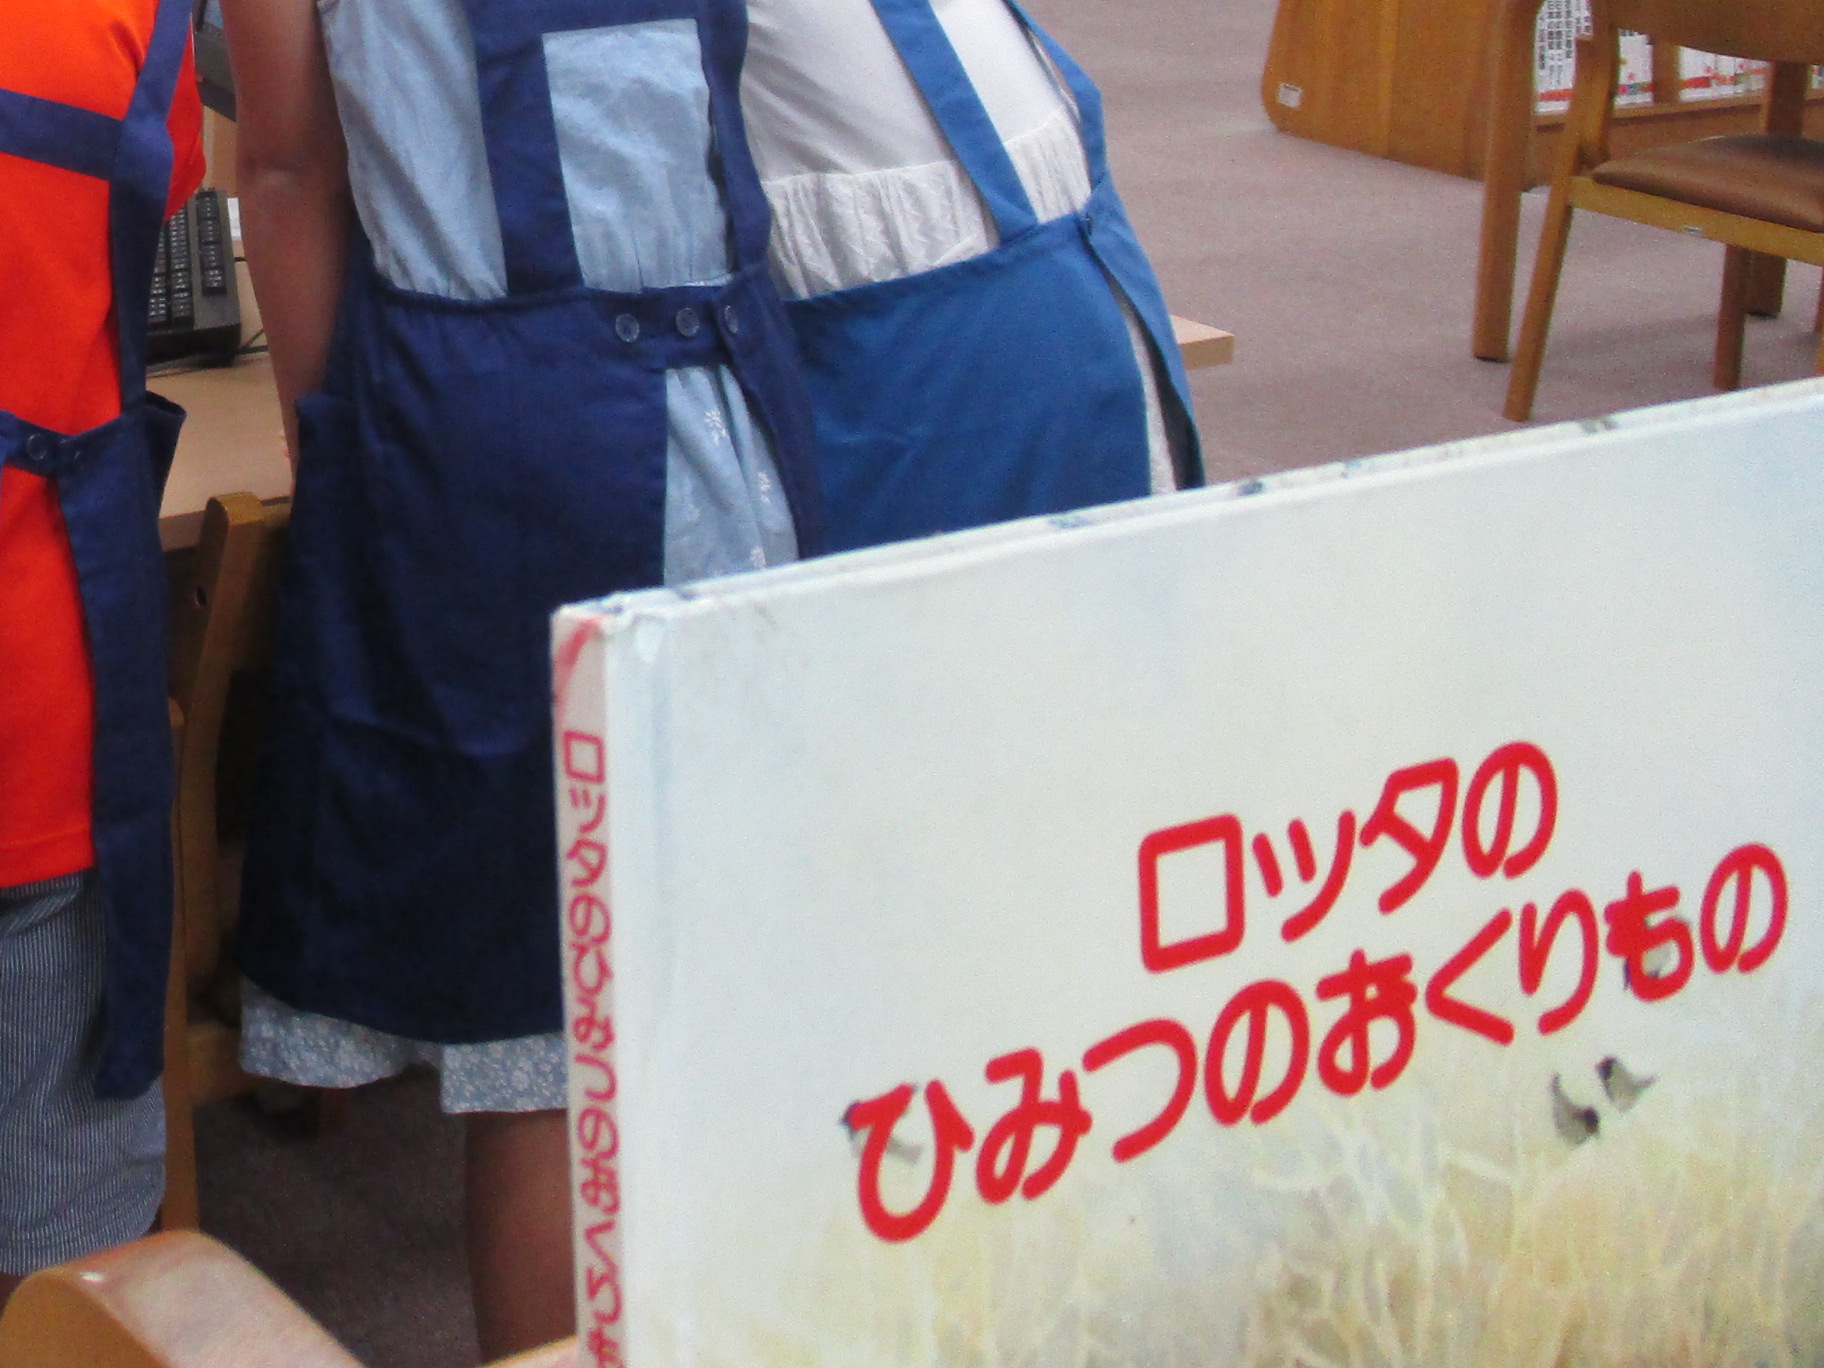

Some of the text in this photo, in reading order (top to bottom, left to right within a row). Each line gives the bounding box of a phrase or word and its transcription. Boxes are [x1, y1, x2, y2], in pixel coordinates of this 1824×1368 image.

[1137, 740, 1559, 973] ロッタの
[848, 842, 1790, 1243] ひみつのおくりもの
